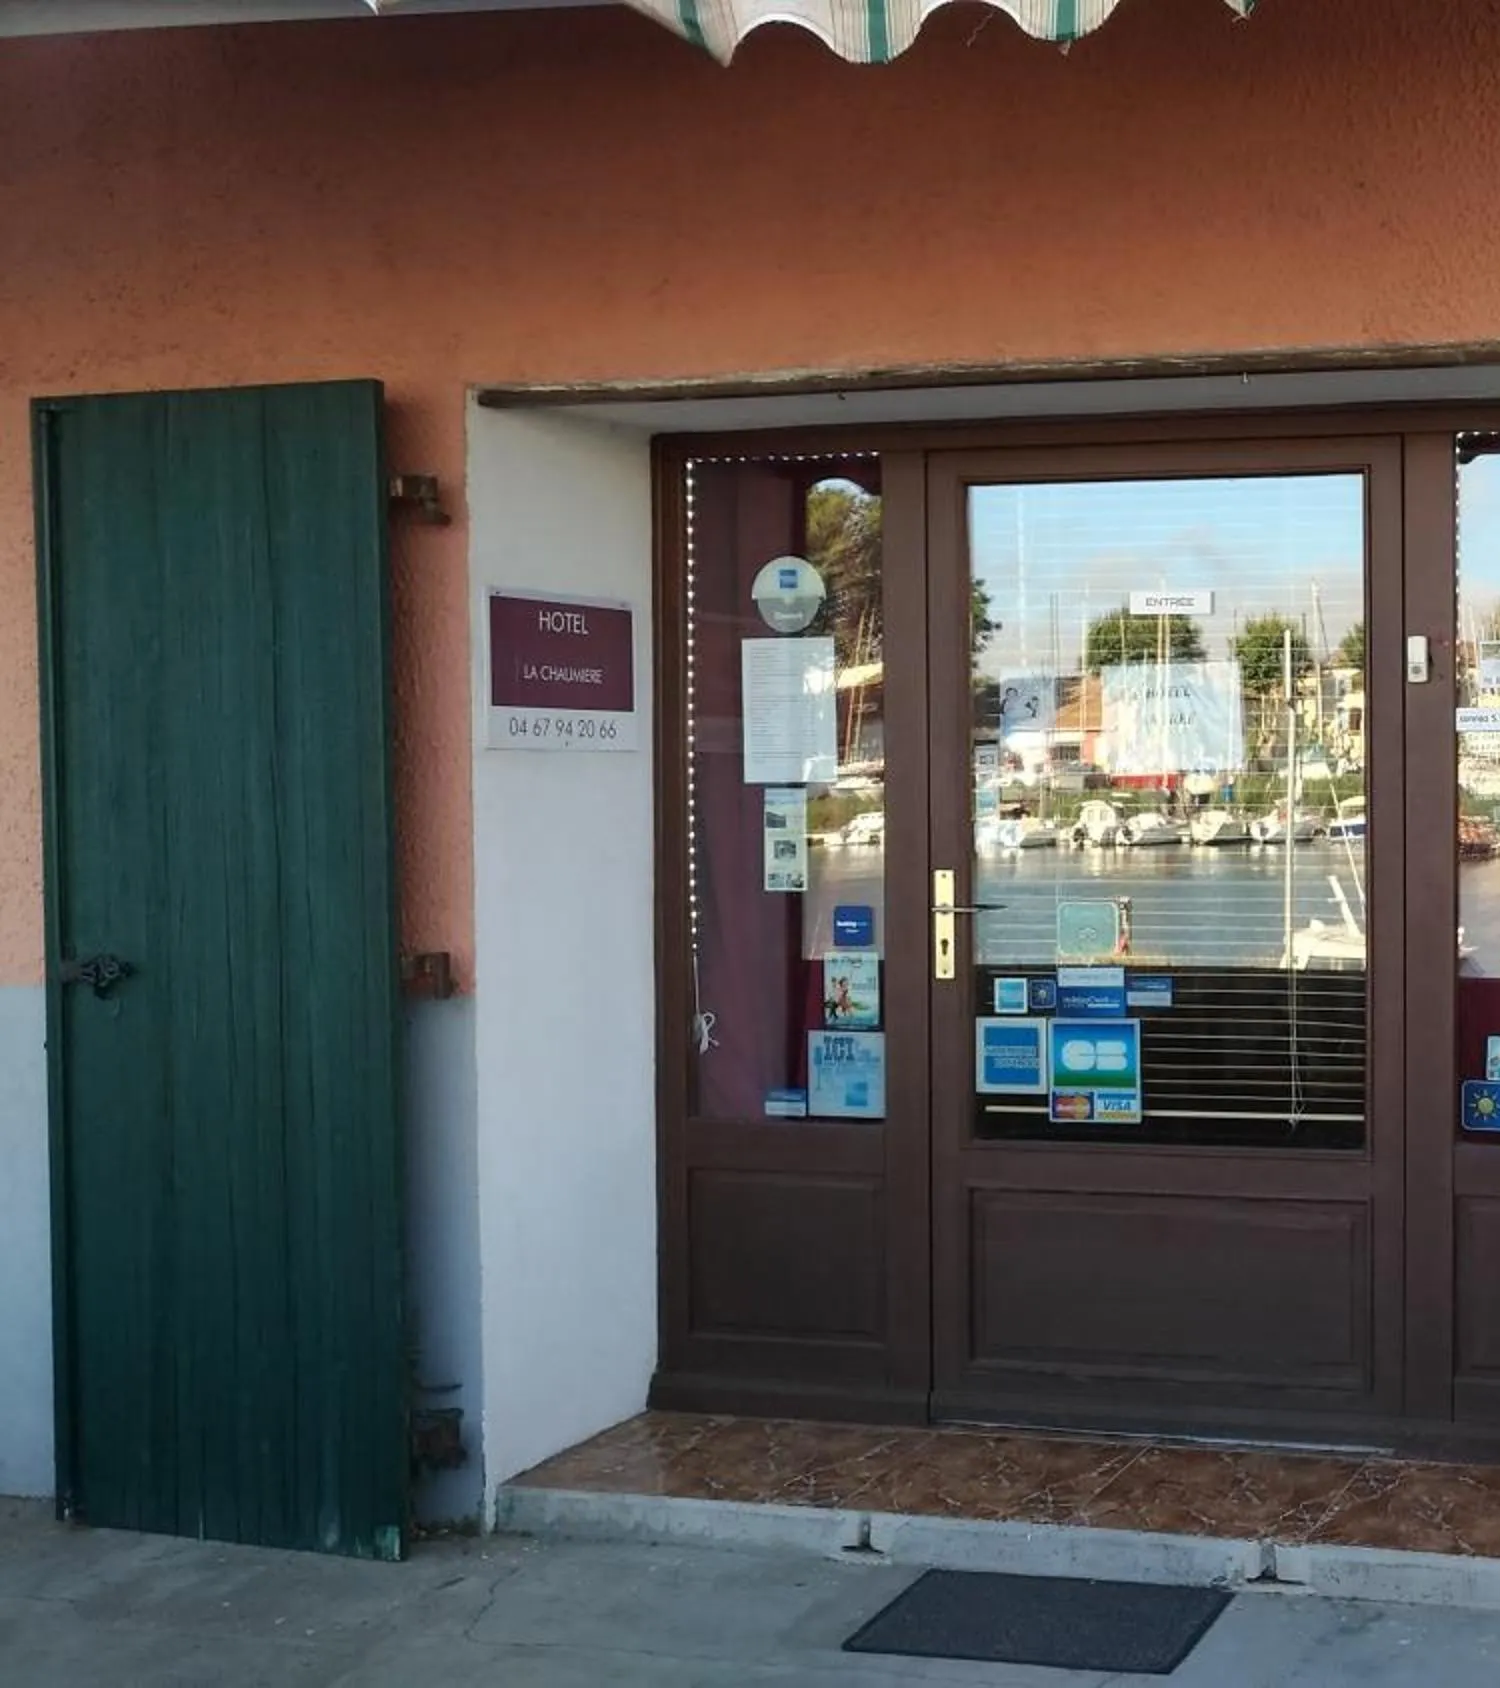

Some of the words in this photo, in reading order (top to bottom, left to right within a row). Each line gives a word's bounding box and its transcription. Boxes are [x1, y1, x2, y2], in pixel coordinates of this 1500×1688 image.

[538, 610, 590, 635] HOTEL
[523, 664, 538, 680] LA
[509, 716, 527, 736] 04
[533, 718, 551, 737] 67
[555, 719, 573, 737] 94
[578, 719, 595, 739] 20
[599, 719, 617, 739] 66
